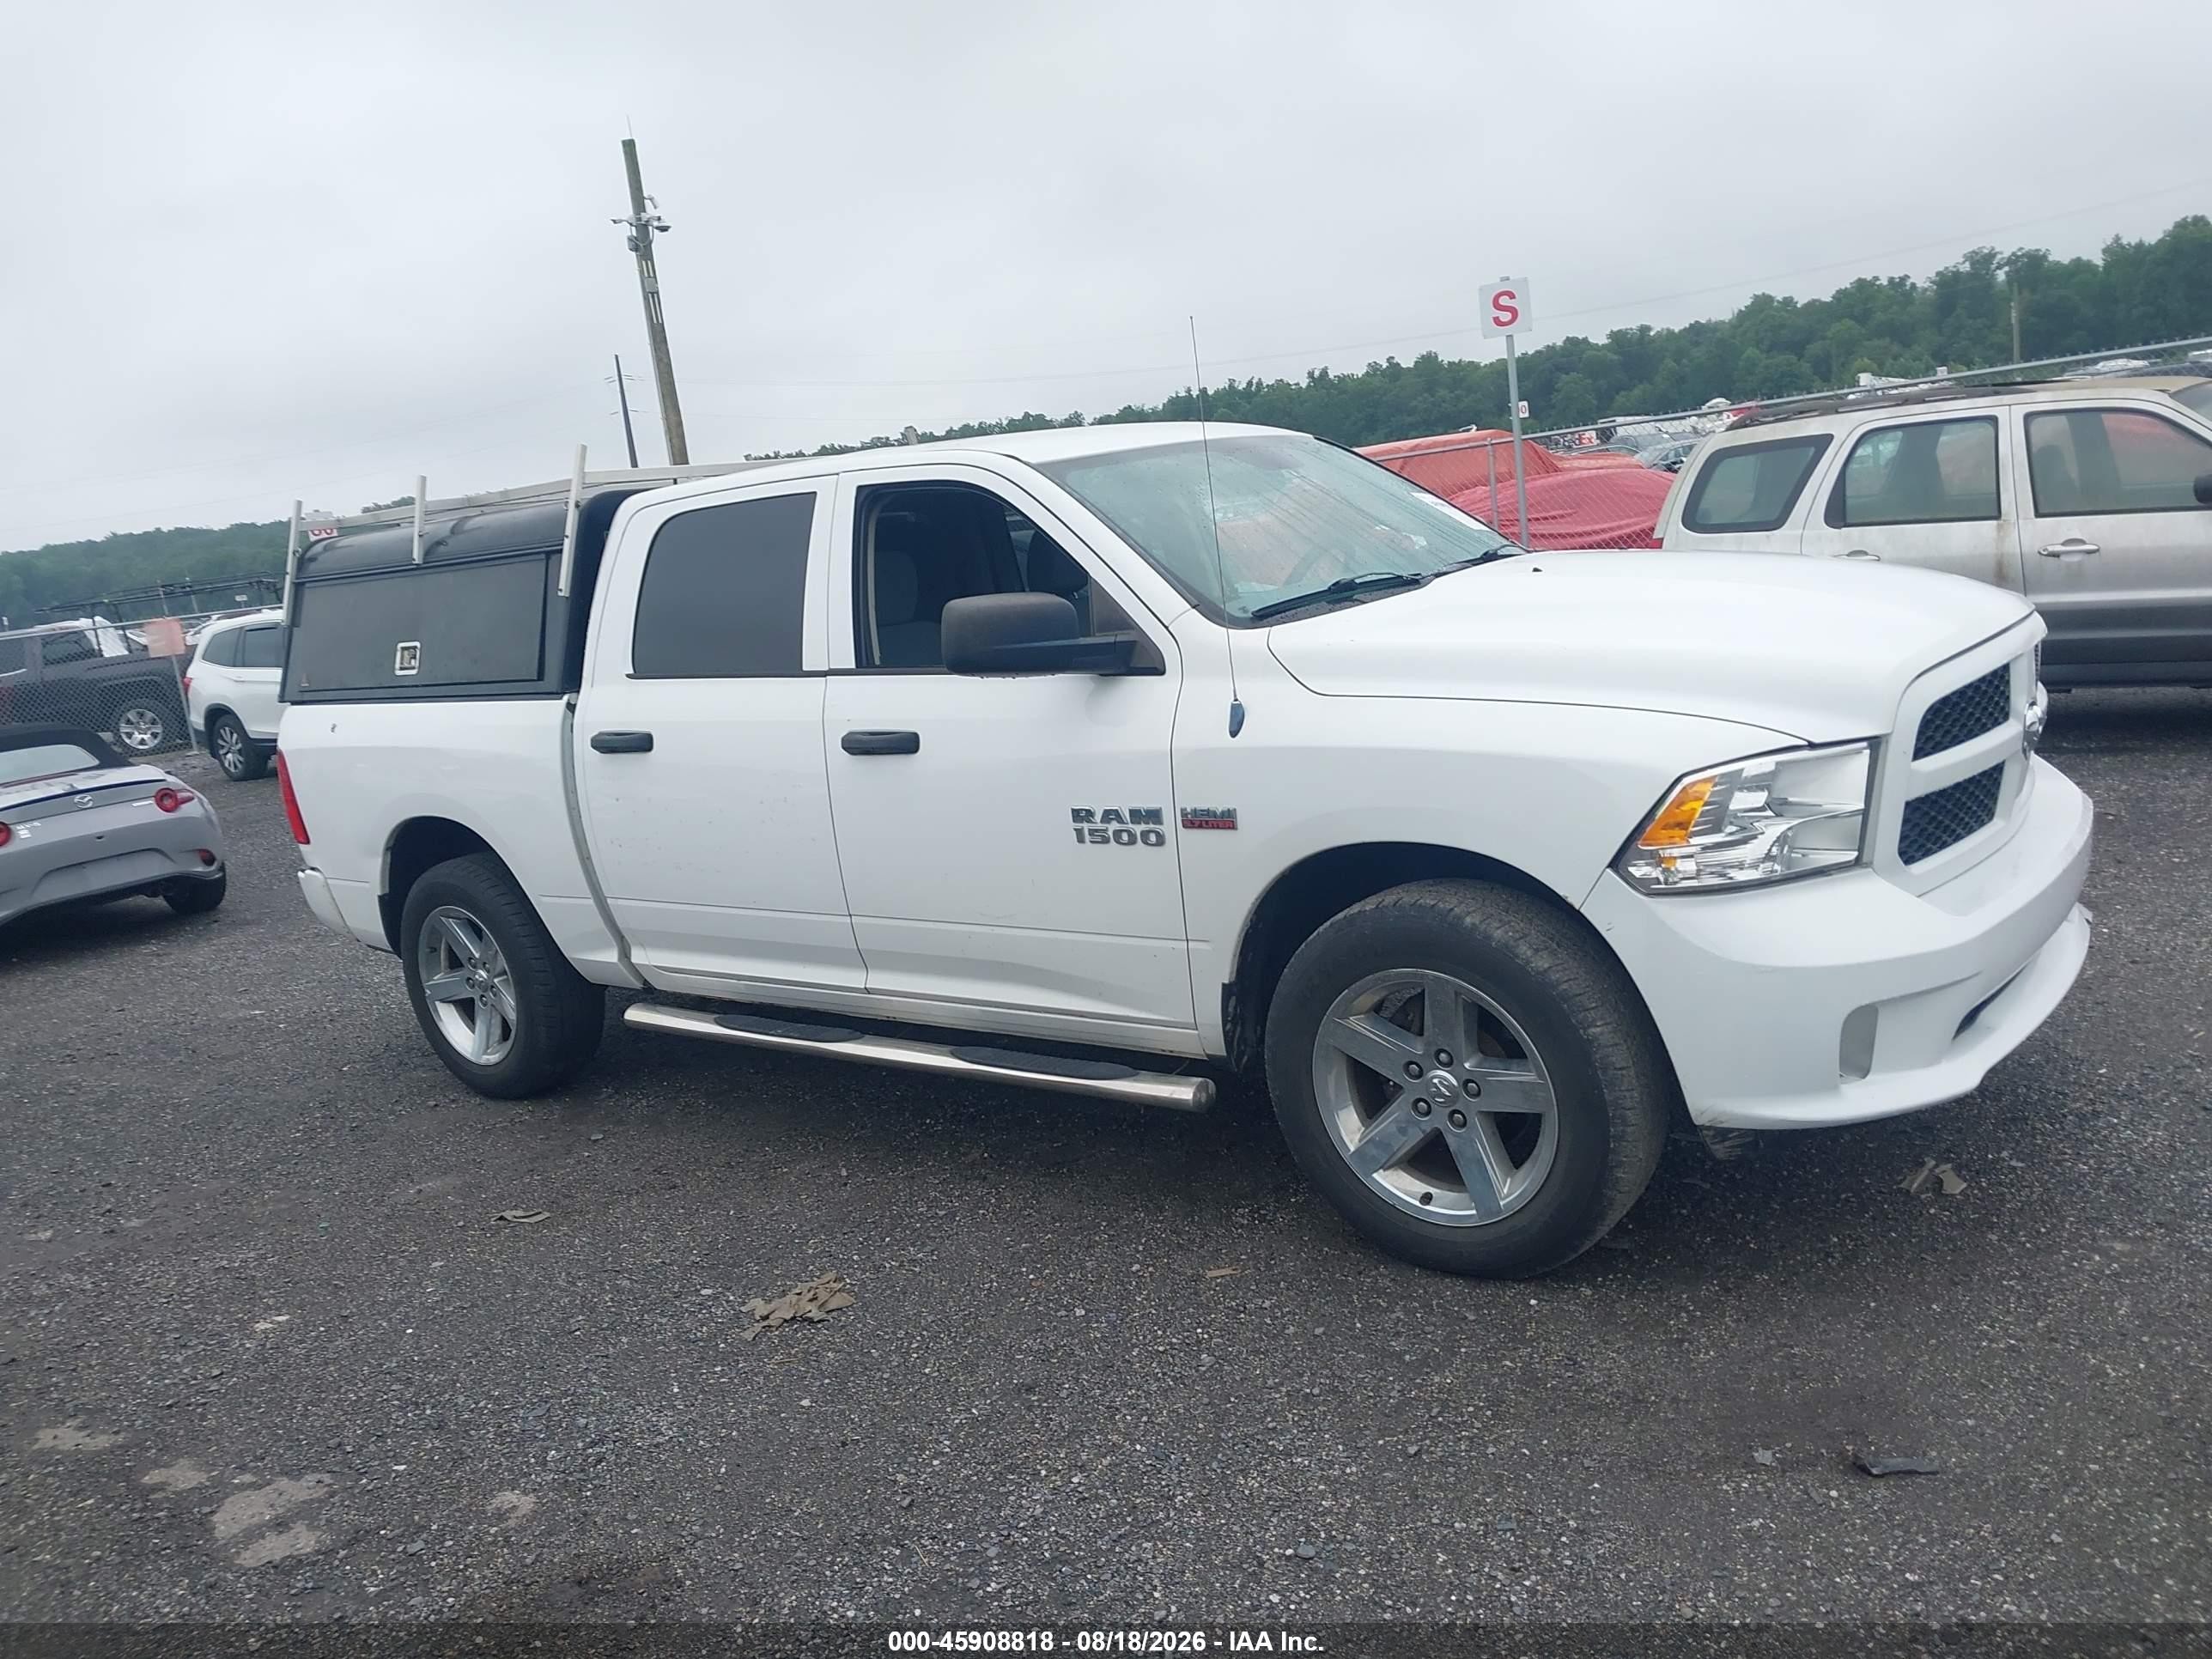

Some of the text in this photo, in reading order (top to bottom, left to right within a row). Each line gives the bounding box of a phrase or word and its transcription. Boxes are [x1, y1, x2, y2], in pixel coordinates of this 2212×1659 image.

[1492, 290, 1518, 327] S
[1071, 805, 1164, 825] RAM
[1181, 807, 1237, 819] HEMI
[1201, 820, 1235, 829] LITER
[1073, 825, 1166, 847] 1500
